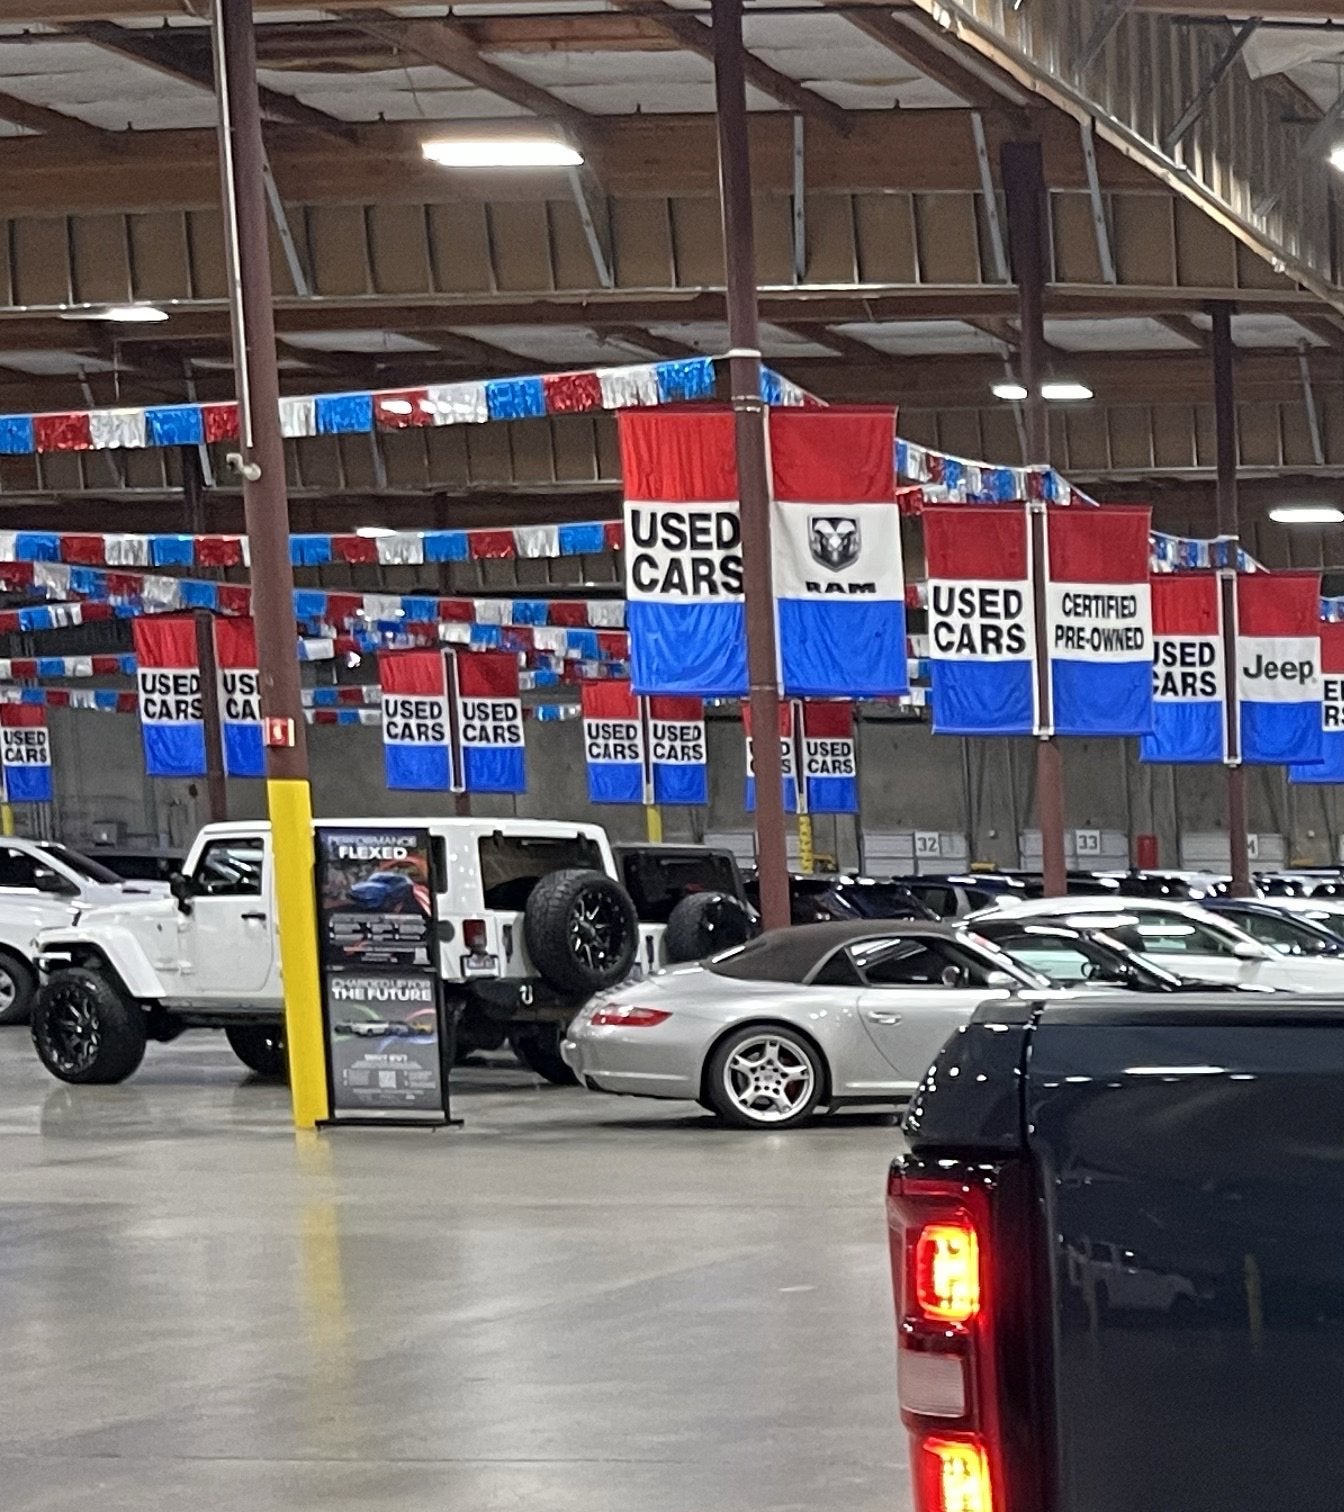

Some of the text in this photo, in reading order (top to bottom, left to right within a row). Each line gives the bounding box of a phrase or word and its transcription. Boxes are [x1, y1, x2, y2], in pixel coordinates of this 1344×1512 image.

[631, 509, 741, 551] USED
[632, 553, 744, 595] CARS
[805, 580, 876, 594] RAM
[933, 585, 1023, 619] USED
[1062, 592, 1137, 618] CERTIFIED
[934, 621, 1026, 654] CARS
[1055, 624, 1144, 652] PRE-OWNED
[1244, 654, 1313, 684] Jeep
[142, 673, 201, 695] USED
[223, 673, 258, 695] US
[143, 698, 202, 720] CARS
[226, 698, 259, 719] CA
[385, 699, 443, 720] USED
[463, 702, 517, 722] USED
[4, 731, 46, 746] USED
[386, 722, 445, 742] CARS
[463, 723, 521, 744] CARS
[587, 722, 638, 741] USED
[653, 723, 702, 742] USED
[5, 747, 47, 763] CARS
[588, 742, 640, 760] CARS
[653, 743, 703, 761] CARS
[806, 741, 850, 757] USED
[807, 758, 853, 774] CARS
[916, 836, 938, 852] 32
[1078, 834, 1099, 851] 33
[339, 846, 408, 860] FLEXED
[332, 987, 432, 1002] THE FUTURE
